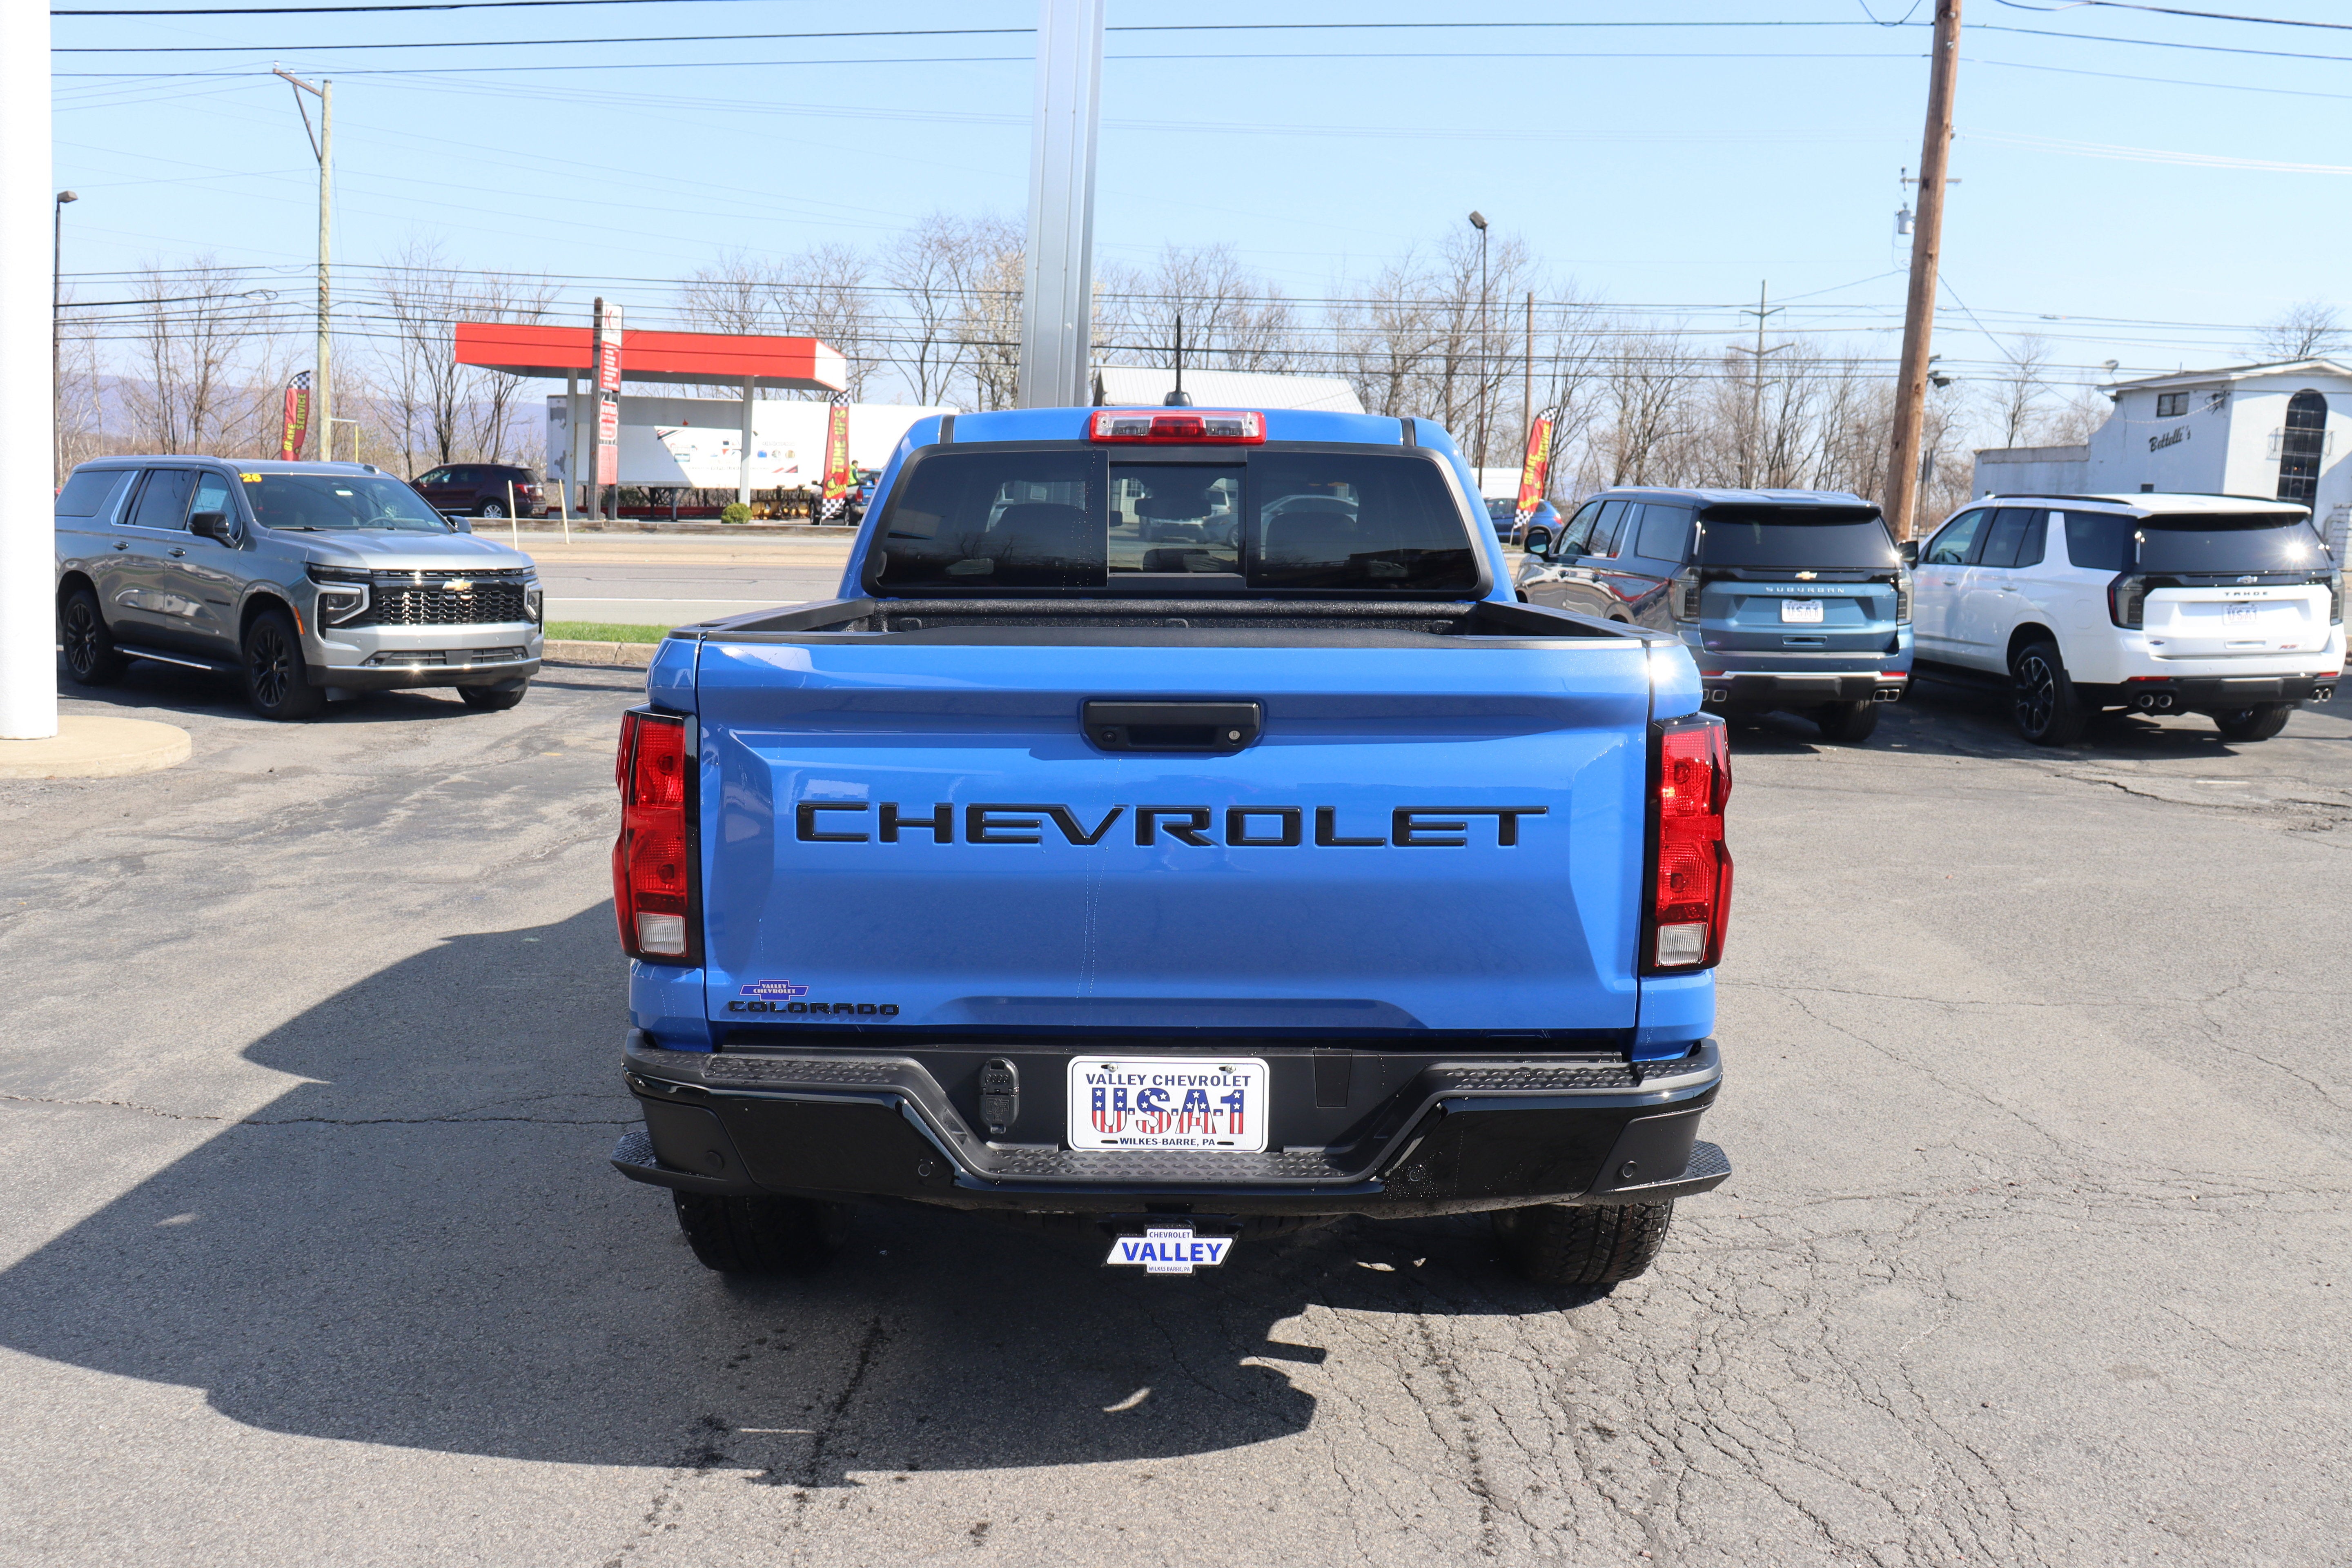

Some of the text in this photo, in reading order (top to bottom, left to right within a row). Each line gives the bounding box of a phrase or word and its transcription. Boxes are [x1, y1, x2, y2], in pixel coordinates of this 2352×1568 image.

[296, 393, 307, 430] SERVICE
[283, 423, 296, 451] BRAKE
[831, 409, 847, 474] TUNE-UPS
[1537, 422, 1551, 462] SERVICE
[2149, 425, 2191, 452] Bettelli's
[1523, 453, 1538, 486] BRAKE
[825, 483, 847, 499] Quality
[796, 803, 1549, 847] CHEVROLET
[728, 1000, 900, 1015] COLORADO
[1085, 1074, 1251, 1087] VALLEY CHEVROLET
[1119, 1137, 1200, 1147] WILKES-BARRE,
[1121, 1242, 1223, 1262] VALLEY
